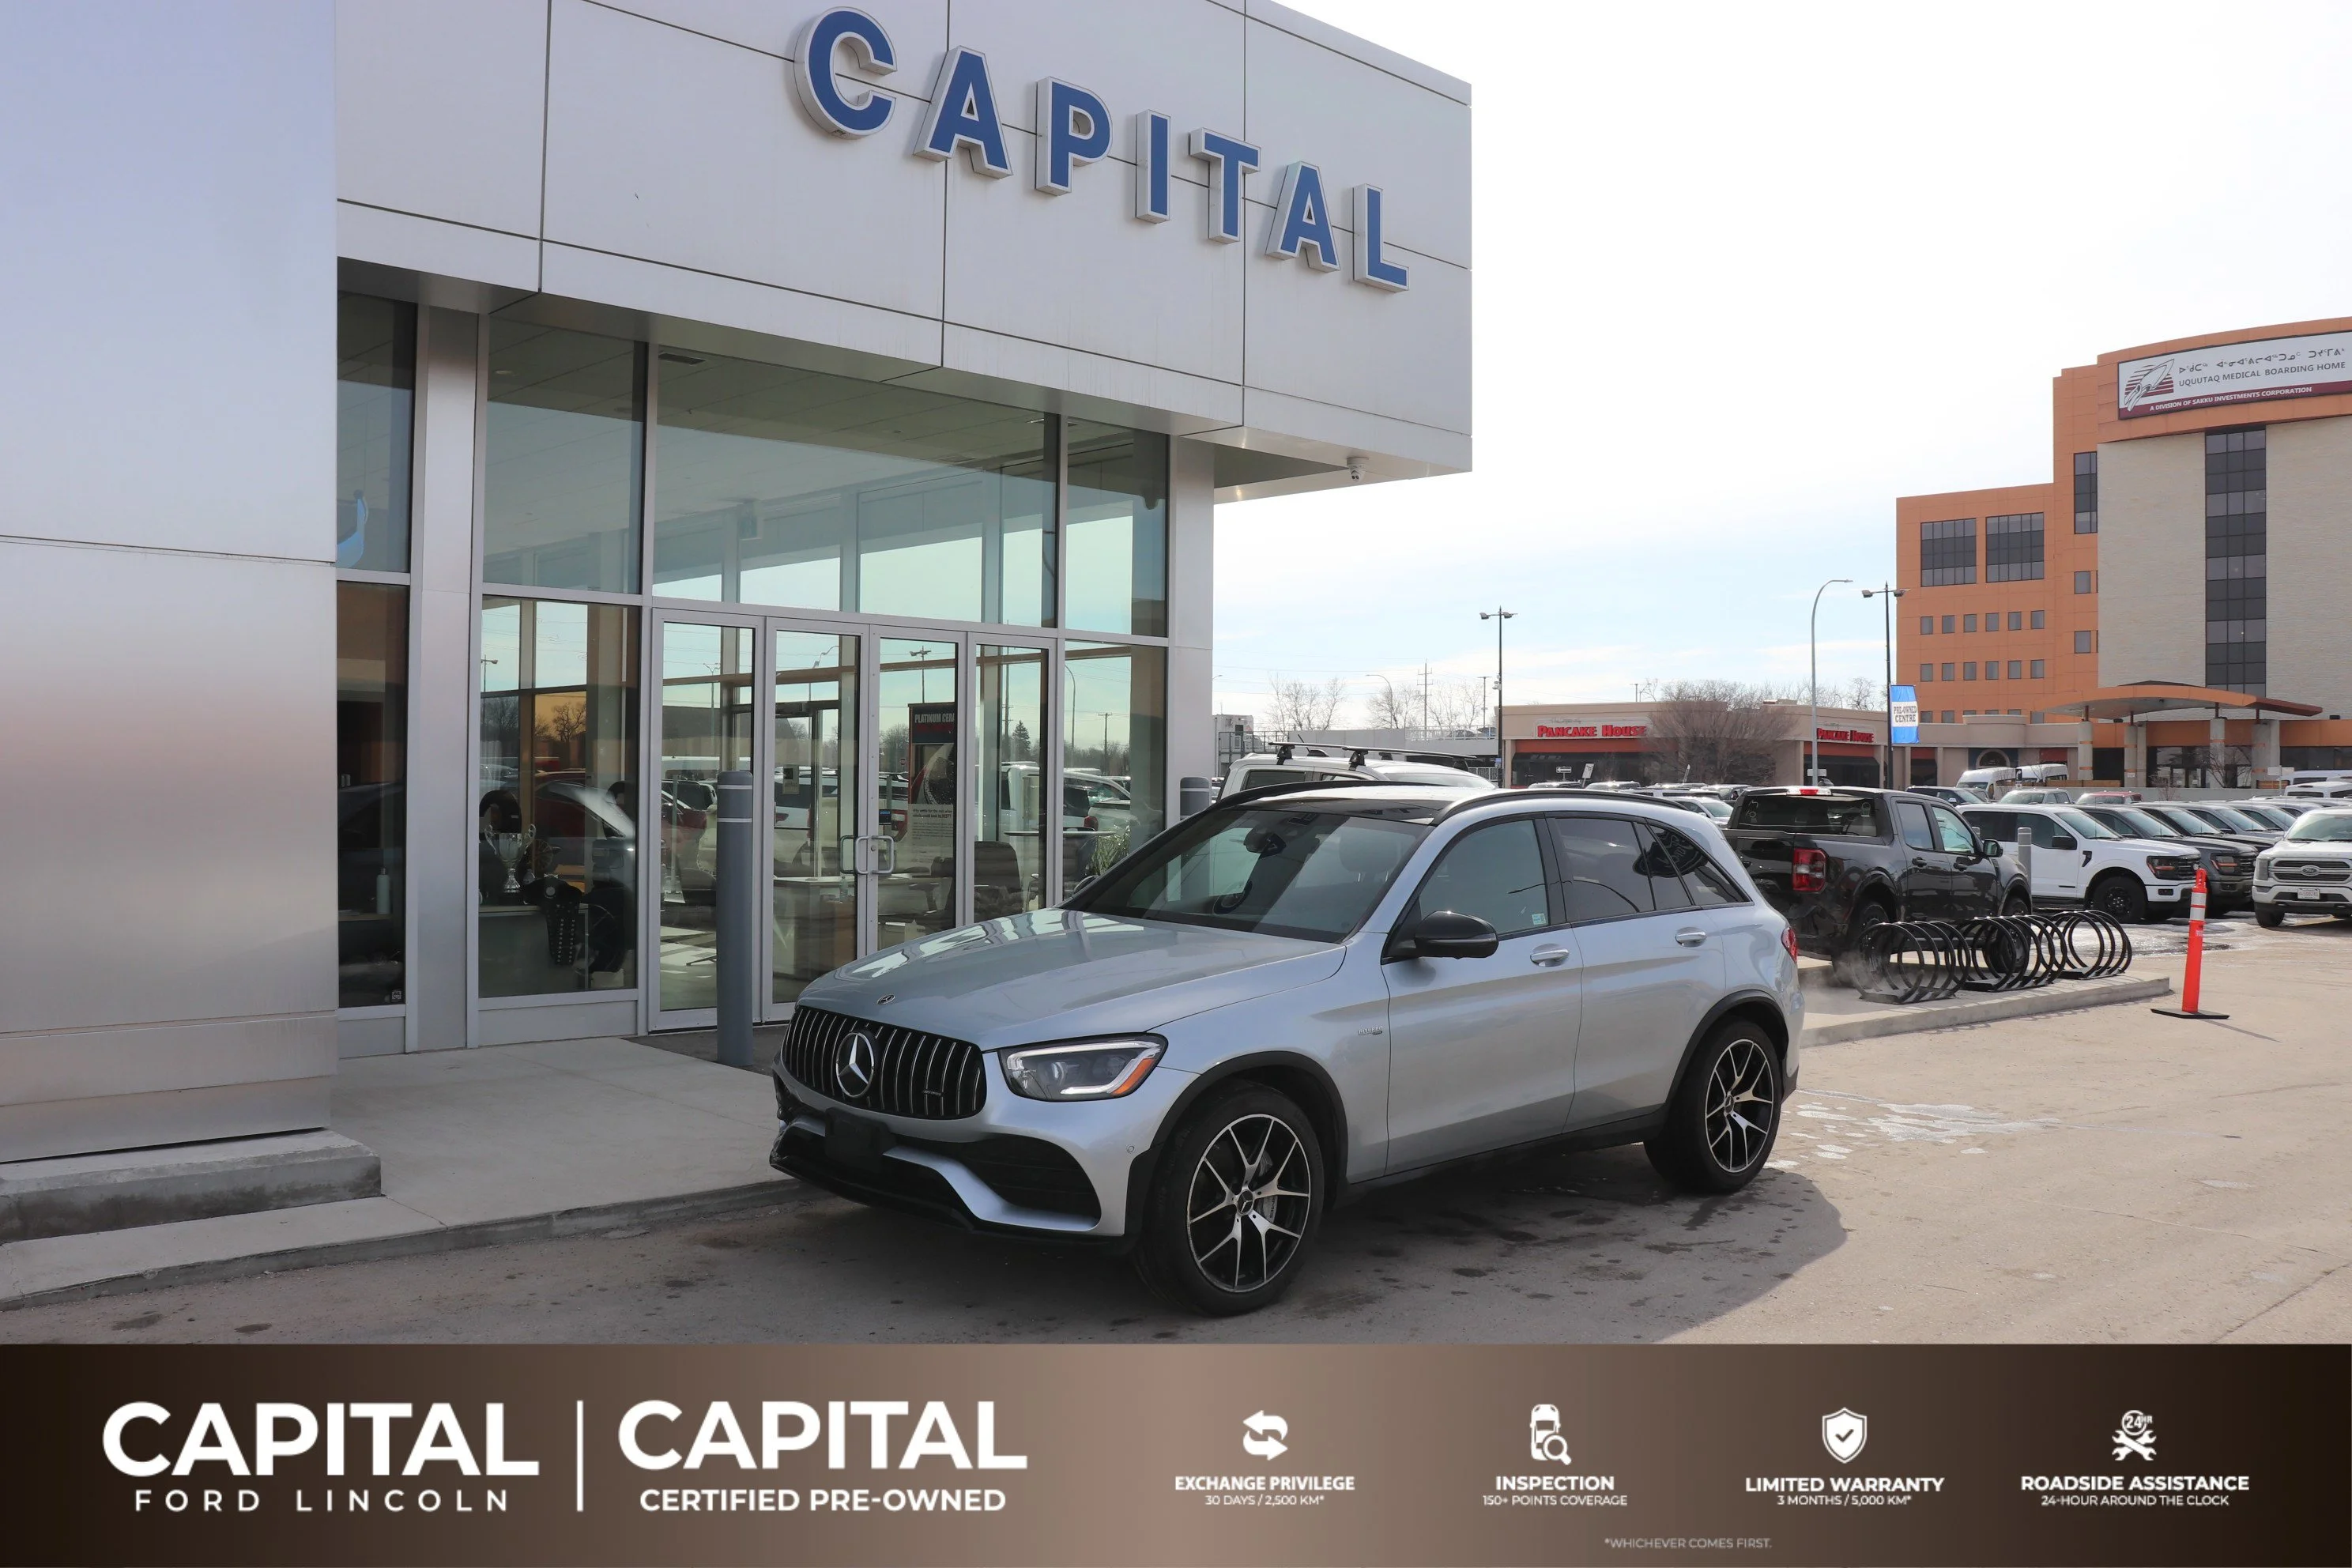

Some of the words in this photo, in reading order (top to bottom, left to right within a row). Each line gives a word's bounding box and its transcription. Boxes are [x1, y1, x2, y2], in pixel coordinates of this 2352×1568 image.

[794, 6, 1411, 292] CAPITAL
[2179, 375, 2220, 386] UQUUTAQ
[2222, 370, 2260, 380] MEDICAL
[2264, 365, 2314, 375] BOARDING
[2316, 361, 2346, 371] HOME
[2155, 401, 2182, 410] DIVISION
[2214, 392, 2260, 402] INVESTMENTS
[2261, 386, 2312, 397] CORPORATION
[914, 713, 941, 723] PLATINUM
[1894, 706, 1917, 714] PRE-OWNED
[1537, 726, 1597, 737] PANCAKE
[1601, 725, 1647, 737] HOUSE
